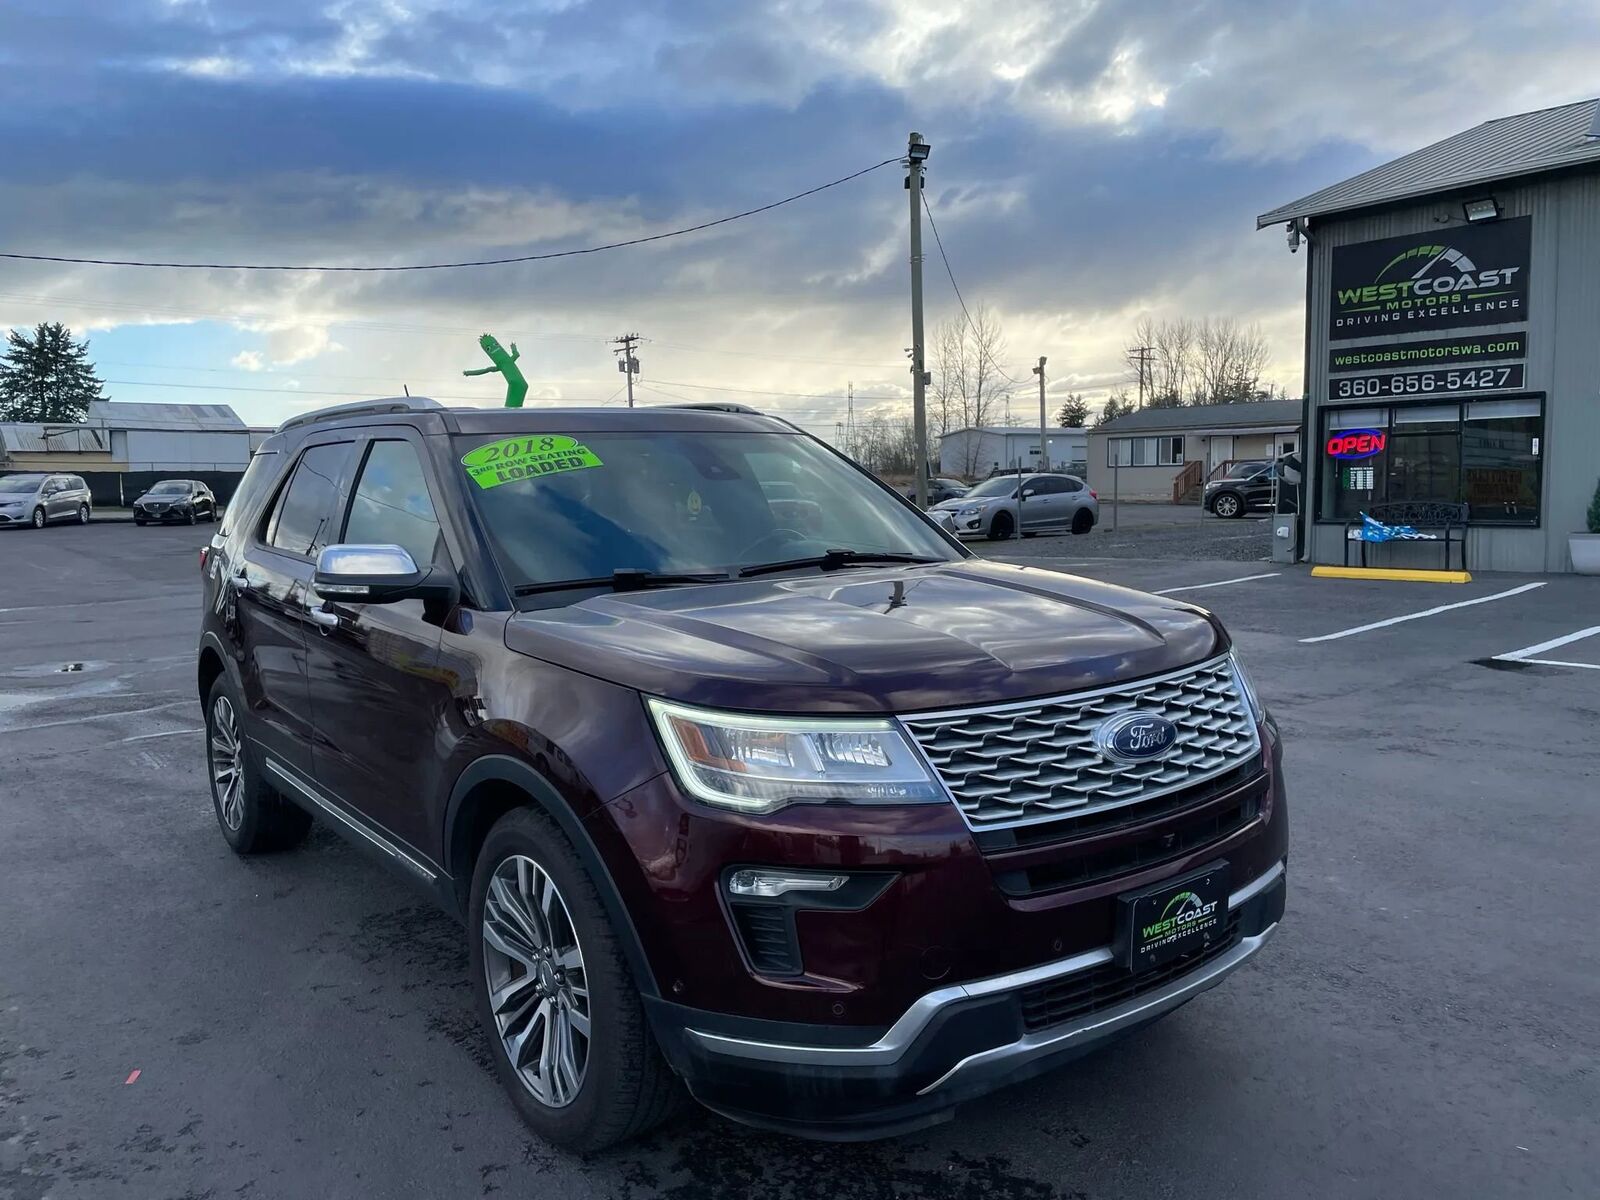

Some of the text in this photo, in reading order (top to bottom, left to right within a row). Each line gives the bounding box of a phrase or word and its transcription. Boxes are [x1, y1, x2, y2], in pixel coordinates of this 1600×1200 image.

[1337, 266, 1521, 305] WESTCOAST
[1336, 299, 1520, 327] DRIVING EXCELLENCE
[1386, 293, 1462, 310] MOTORS
[1335, 340, 1520, 366] westcoastmotorswa.com
[1338, 367, 1511, 398] 360-656-5427
[484, 437, 555, 464] 2018
[1327, 433, 1386, 456] OPEN
[471, 448, 585, 477] 3RD ROW SEATING
[495, 456, 584, 482] LOADED
[1130, 723, 1167, 751] Ford
[1142, 900, 1218, 938] WESTCOAST
[1164, 920, 1197, 938] MOTORS
[1140, 918, 1217, 954] DRIVING EXCELLENCE
